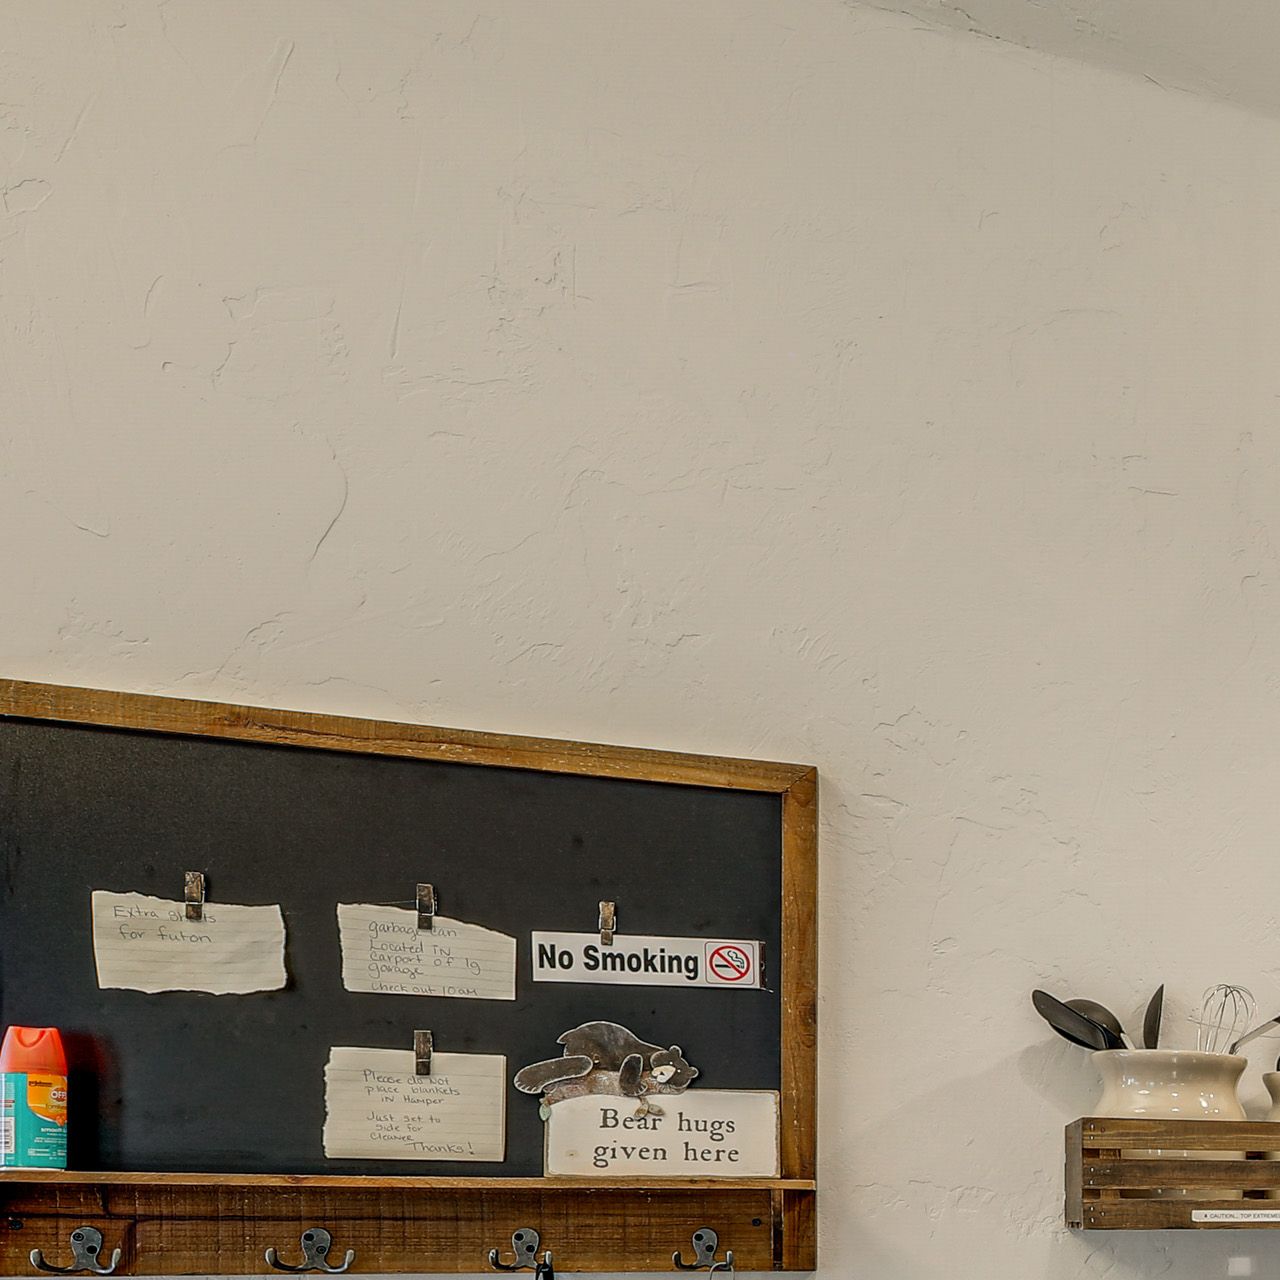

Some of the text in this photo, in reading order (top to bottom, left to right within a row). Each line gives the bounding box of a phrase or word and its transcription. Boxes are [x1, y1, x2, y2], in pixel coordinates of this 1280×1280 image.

[113, 905, 217, 923] Extra Shts
[119, 923, 212, 943] for futon
[368, 920, 424, 941] garbage
[538, 944, 699, 981] No Smoking
[412, 985, 436, 995] out
[363, 1068, 403, 1084] Please
[407, 1075, 424, 1085] do
[366, 1111, 394, 1122] Just
[429, 1116, 441, 1124] to
[599, 1107, 736, 1142] Bear hugs
[593, 1141, 740, 1168] given here
